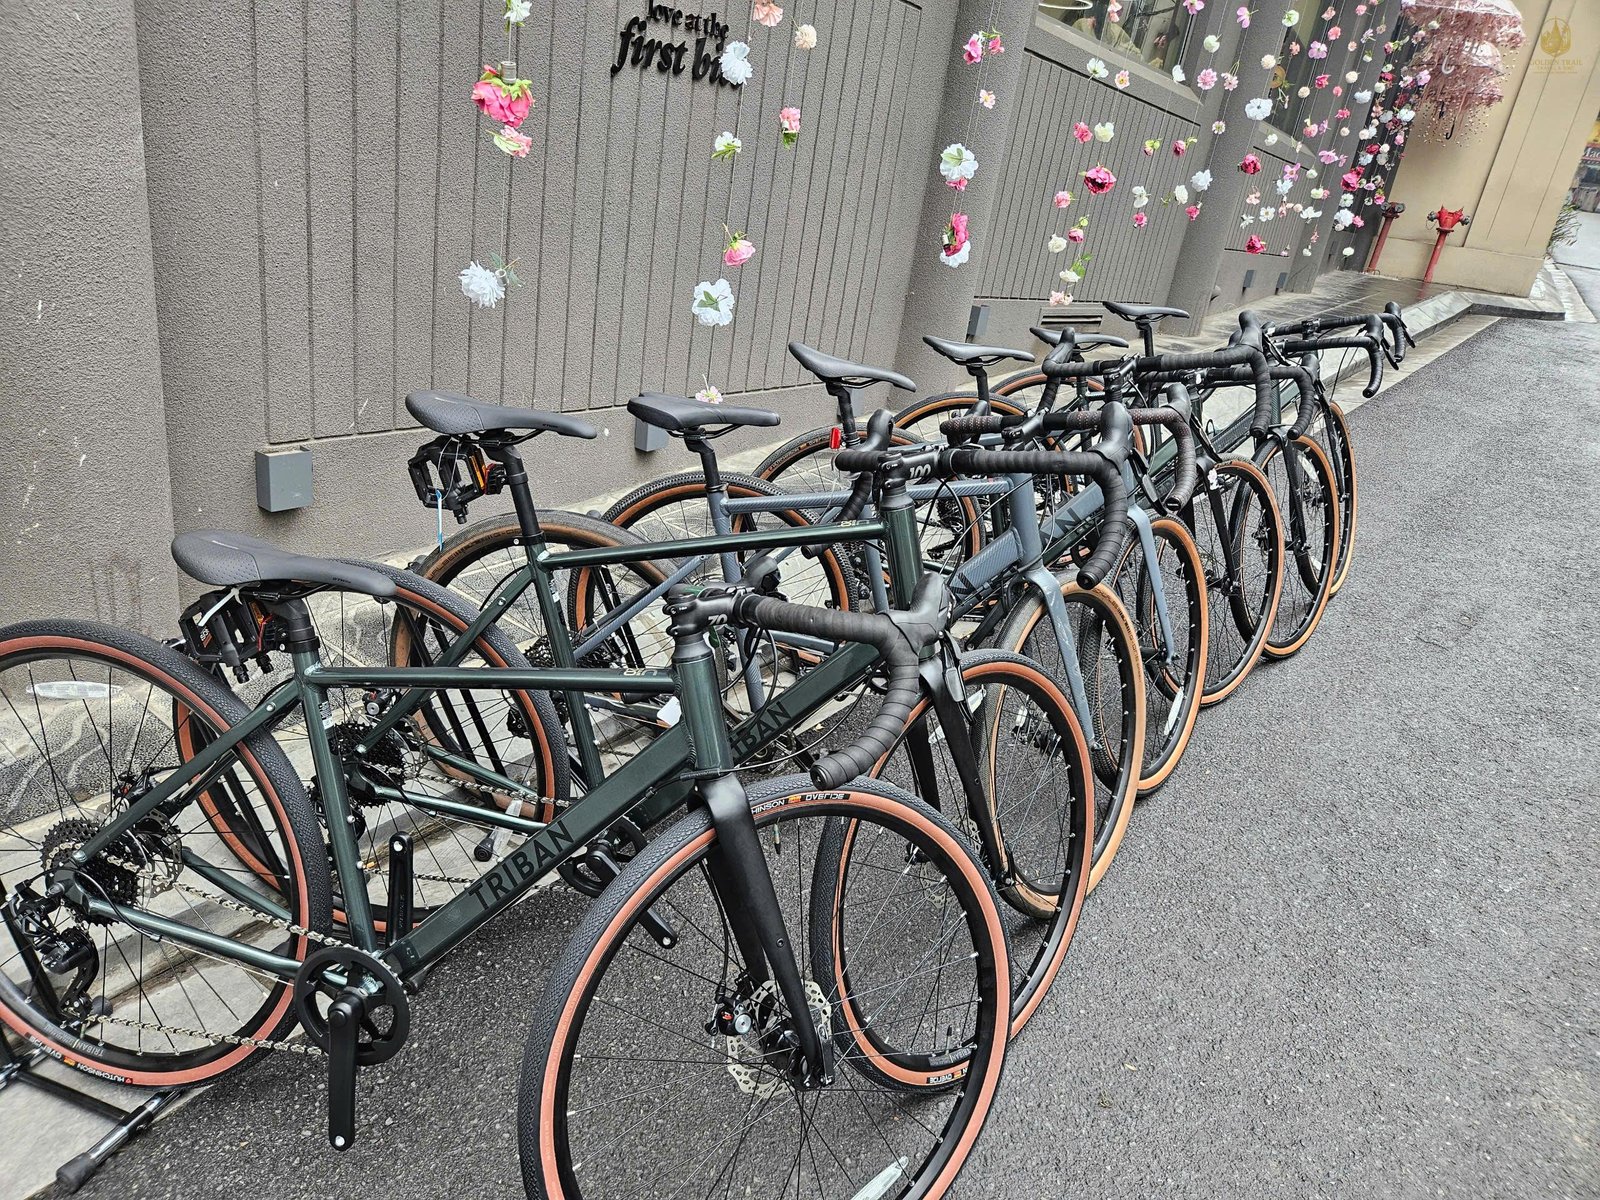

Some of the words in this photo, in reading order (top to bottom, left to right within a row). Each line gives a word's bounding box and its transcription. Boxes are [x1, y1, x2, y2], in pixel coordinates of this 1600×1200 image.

[685, 13, 702, 32] at
[703, 12, 729, 39] the
[610, 16, 689, 78] first
[691, 37, 743, 89] bi
[751, 800, 785, 814] HINSON
[468, 820, 575, 911] TRIBAN
[77, 1063, 125, 1083] HUTCHINSON
